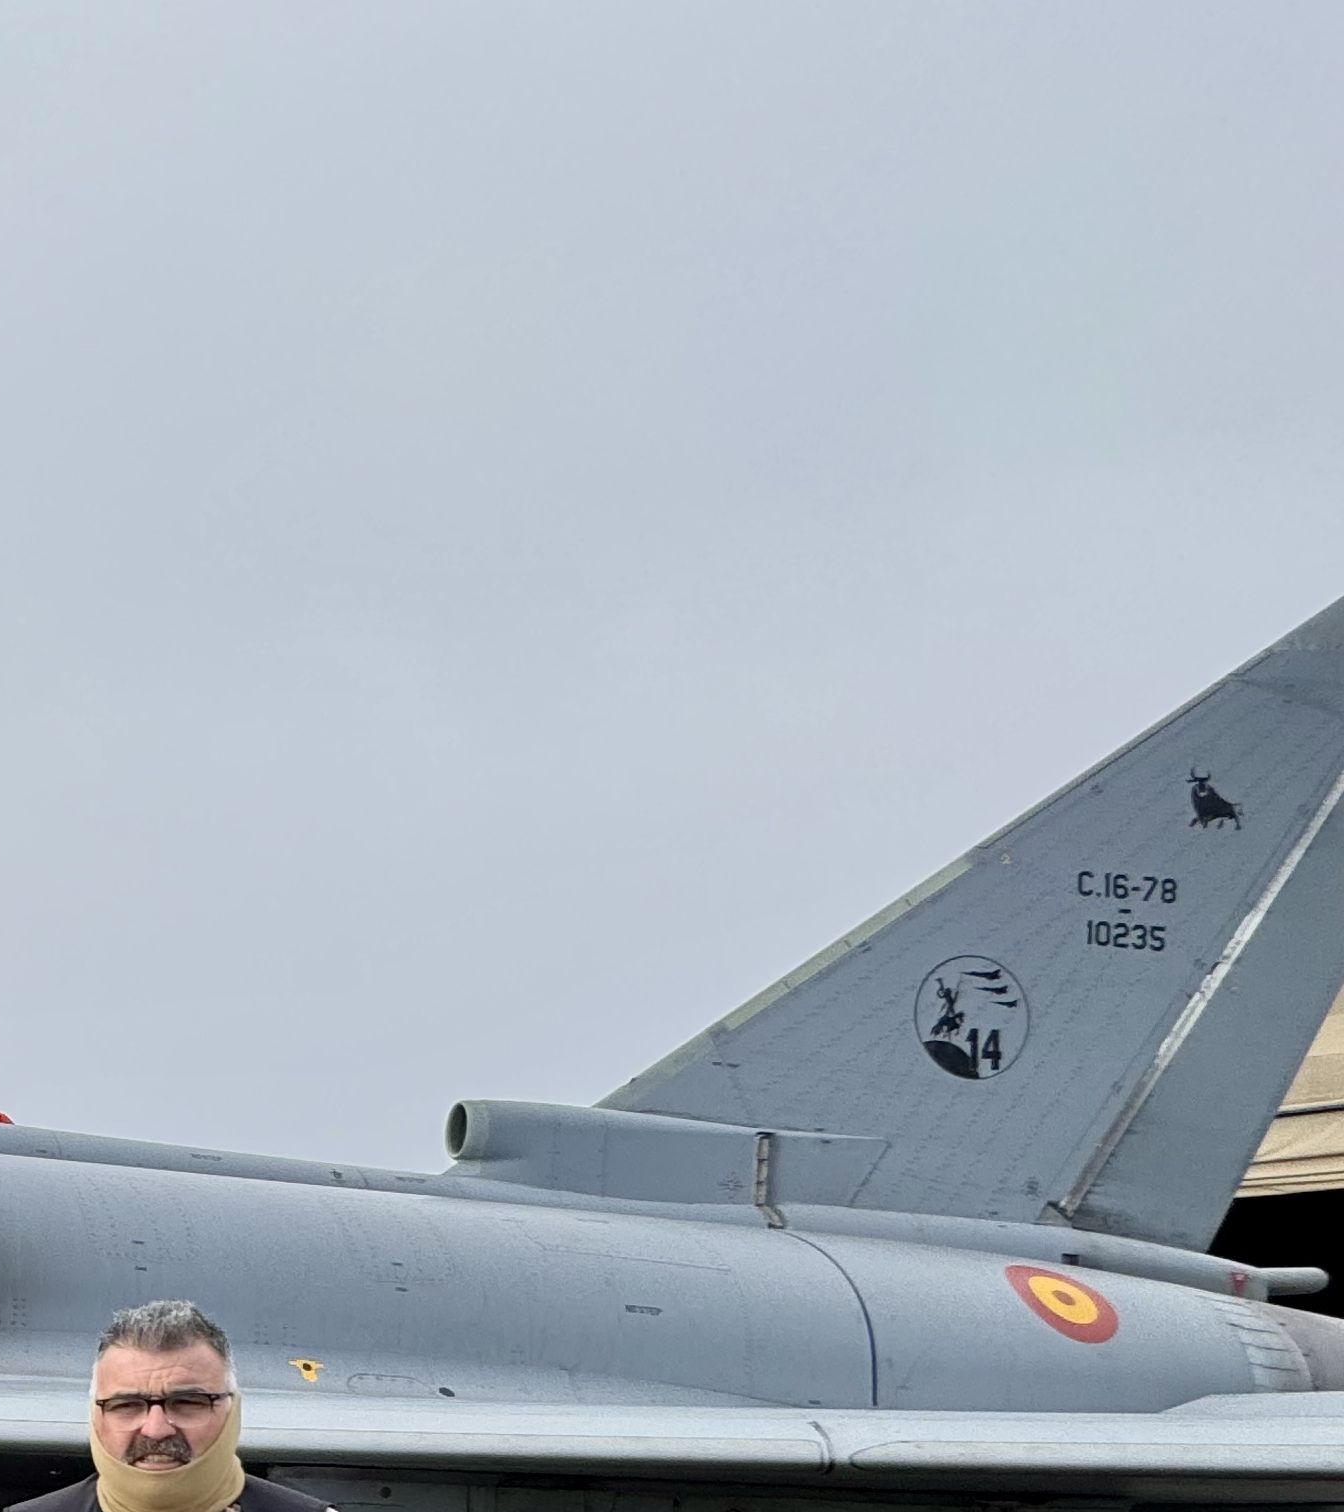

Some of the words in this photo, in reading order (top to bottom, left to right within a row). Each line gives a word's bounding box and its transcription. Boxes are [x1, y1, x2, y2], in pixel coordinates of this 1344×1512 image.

[1078, 871, 1177, 903] C.16-78
[1087, 920, 1166, 951] 10235
[965, 1028, 1002, 1071] 14
